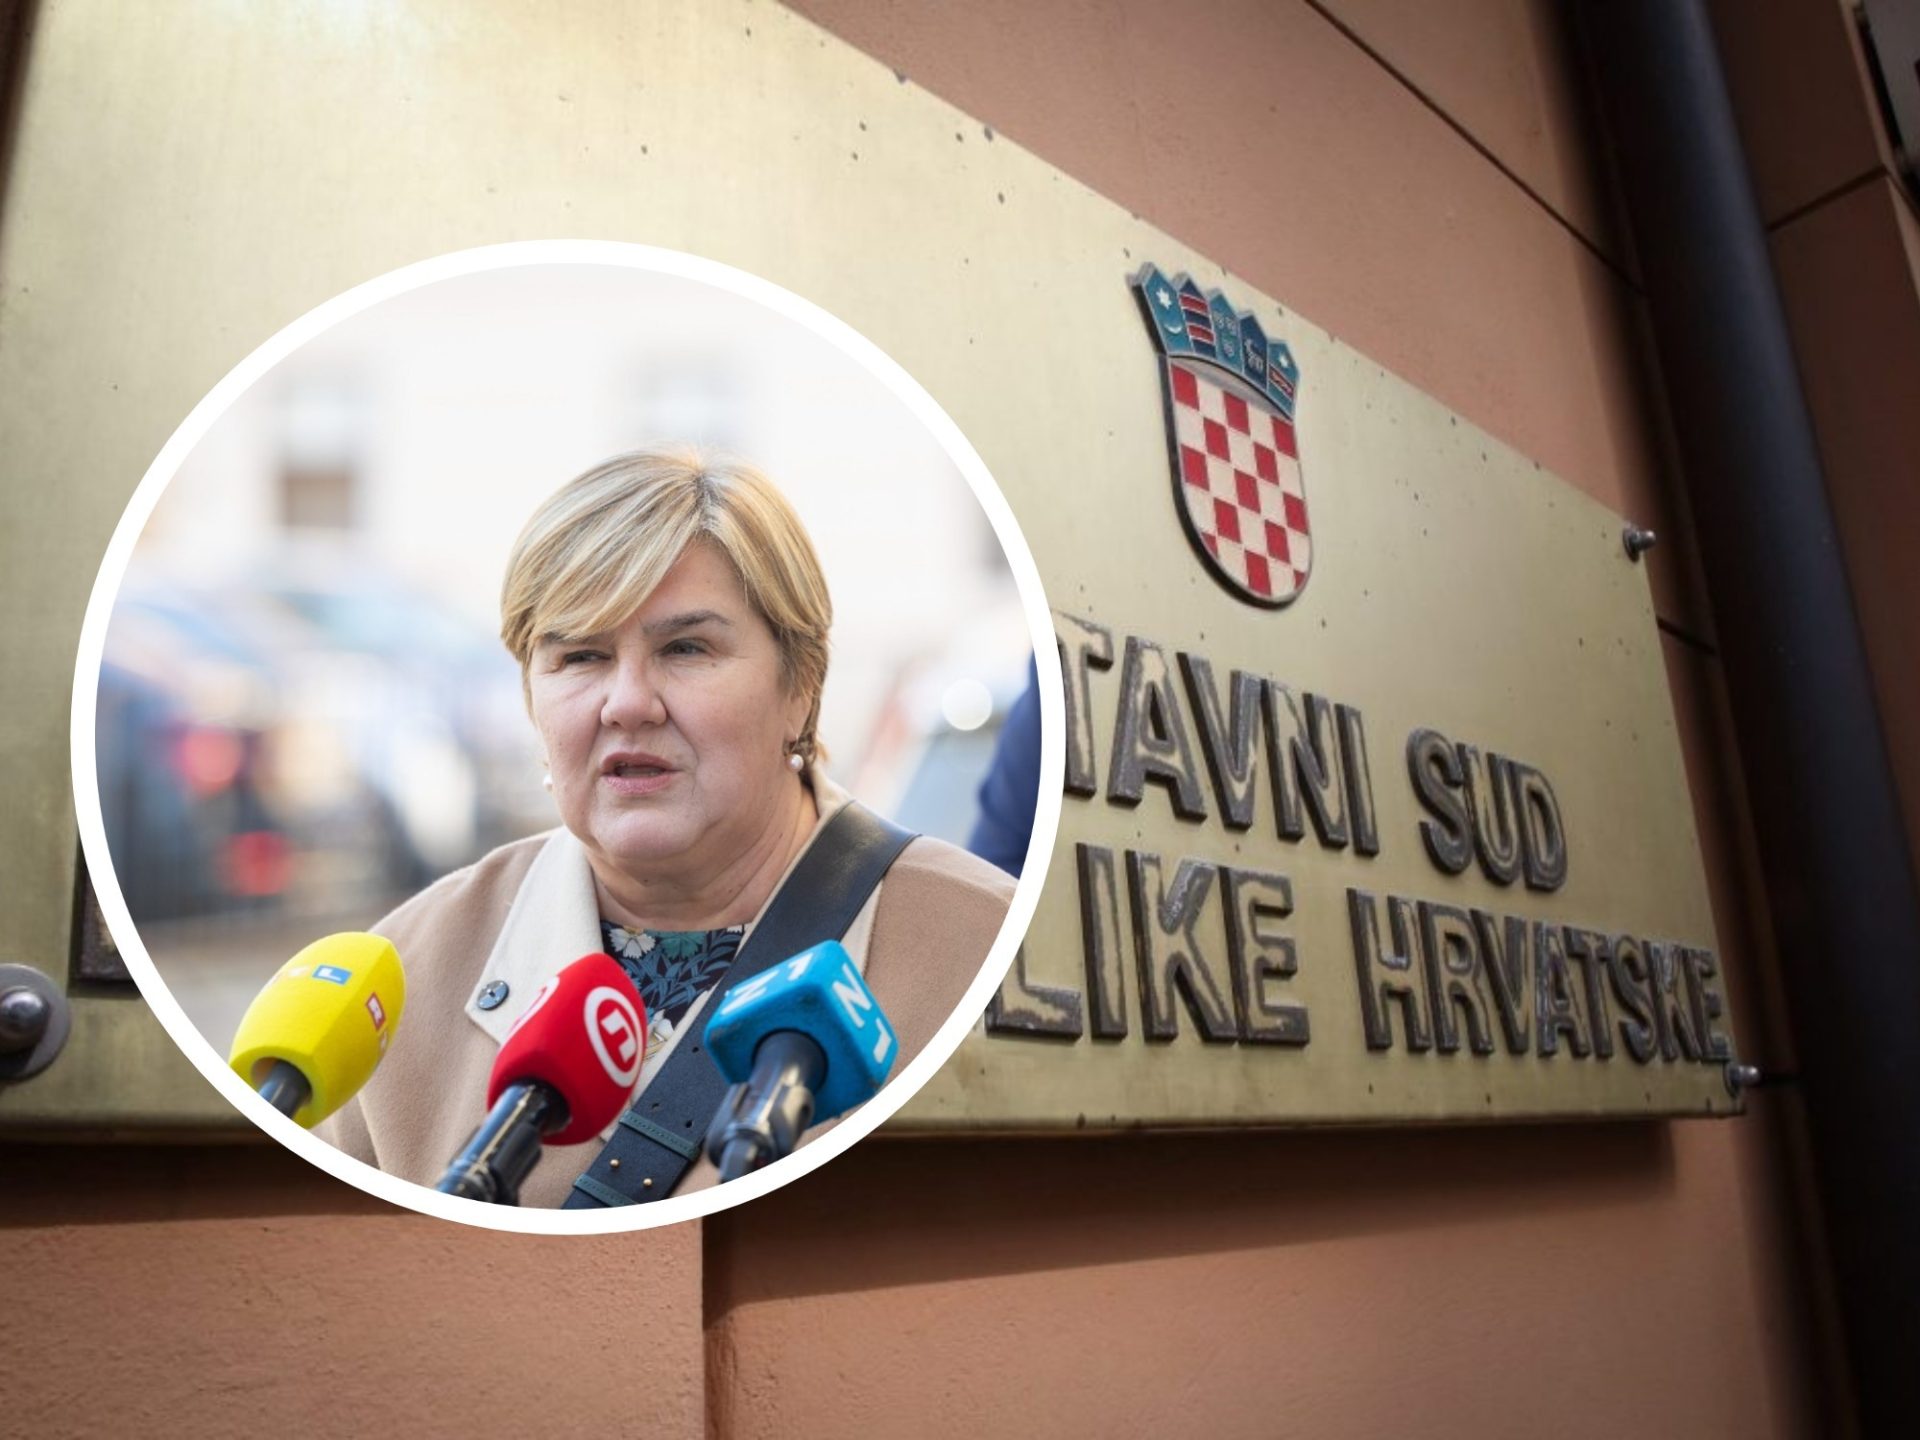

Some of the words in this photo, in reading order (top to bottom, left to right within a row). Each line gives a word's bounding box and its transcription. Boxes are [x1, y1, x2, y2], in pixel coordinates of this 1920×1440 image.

[1406, 728, 1567, 892] SUD
[721, 952, 814, 1015] N1
[832, 962, 892, 1064] N1
[1346, 887, 1730, 1064] HRVATSKE
